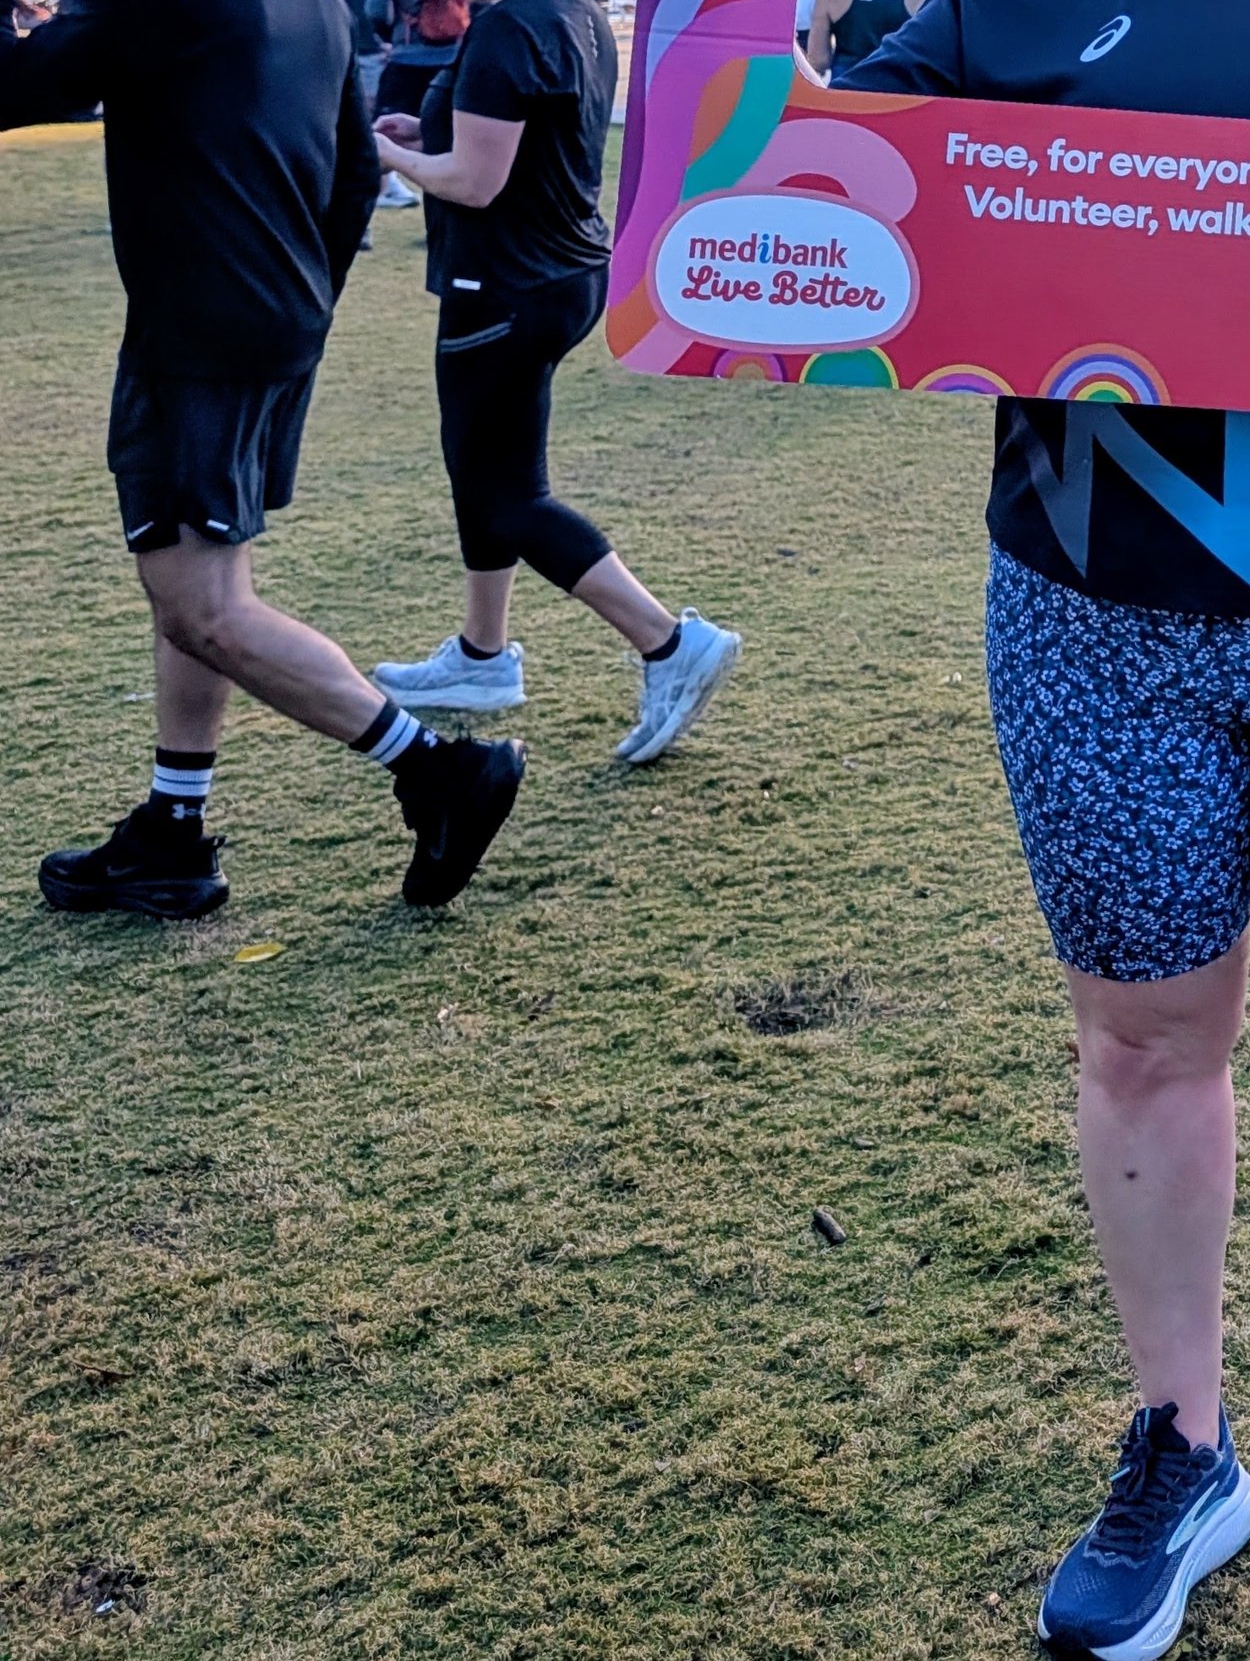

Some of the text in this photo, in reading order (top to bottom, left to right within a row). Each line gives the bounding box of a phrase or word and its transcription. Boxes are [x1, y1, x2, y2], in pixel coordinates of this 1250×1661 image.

[945, 132, 1038, 177] Free,
[1046, 138, 1103, 175] for
[964, 184, 1159, 236] Volunteer,
[688, 232, 849, 270] medibank
[681, 264, 886, 312] Live Better
